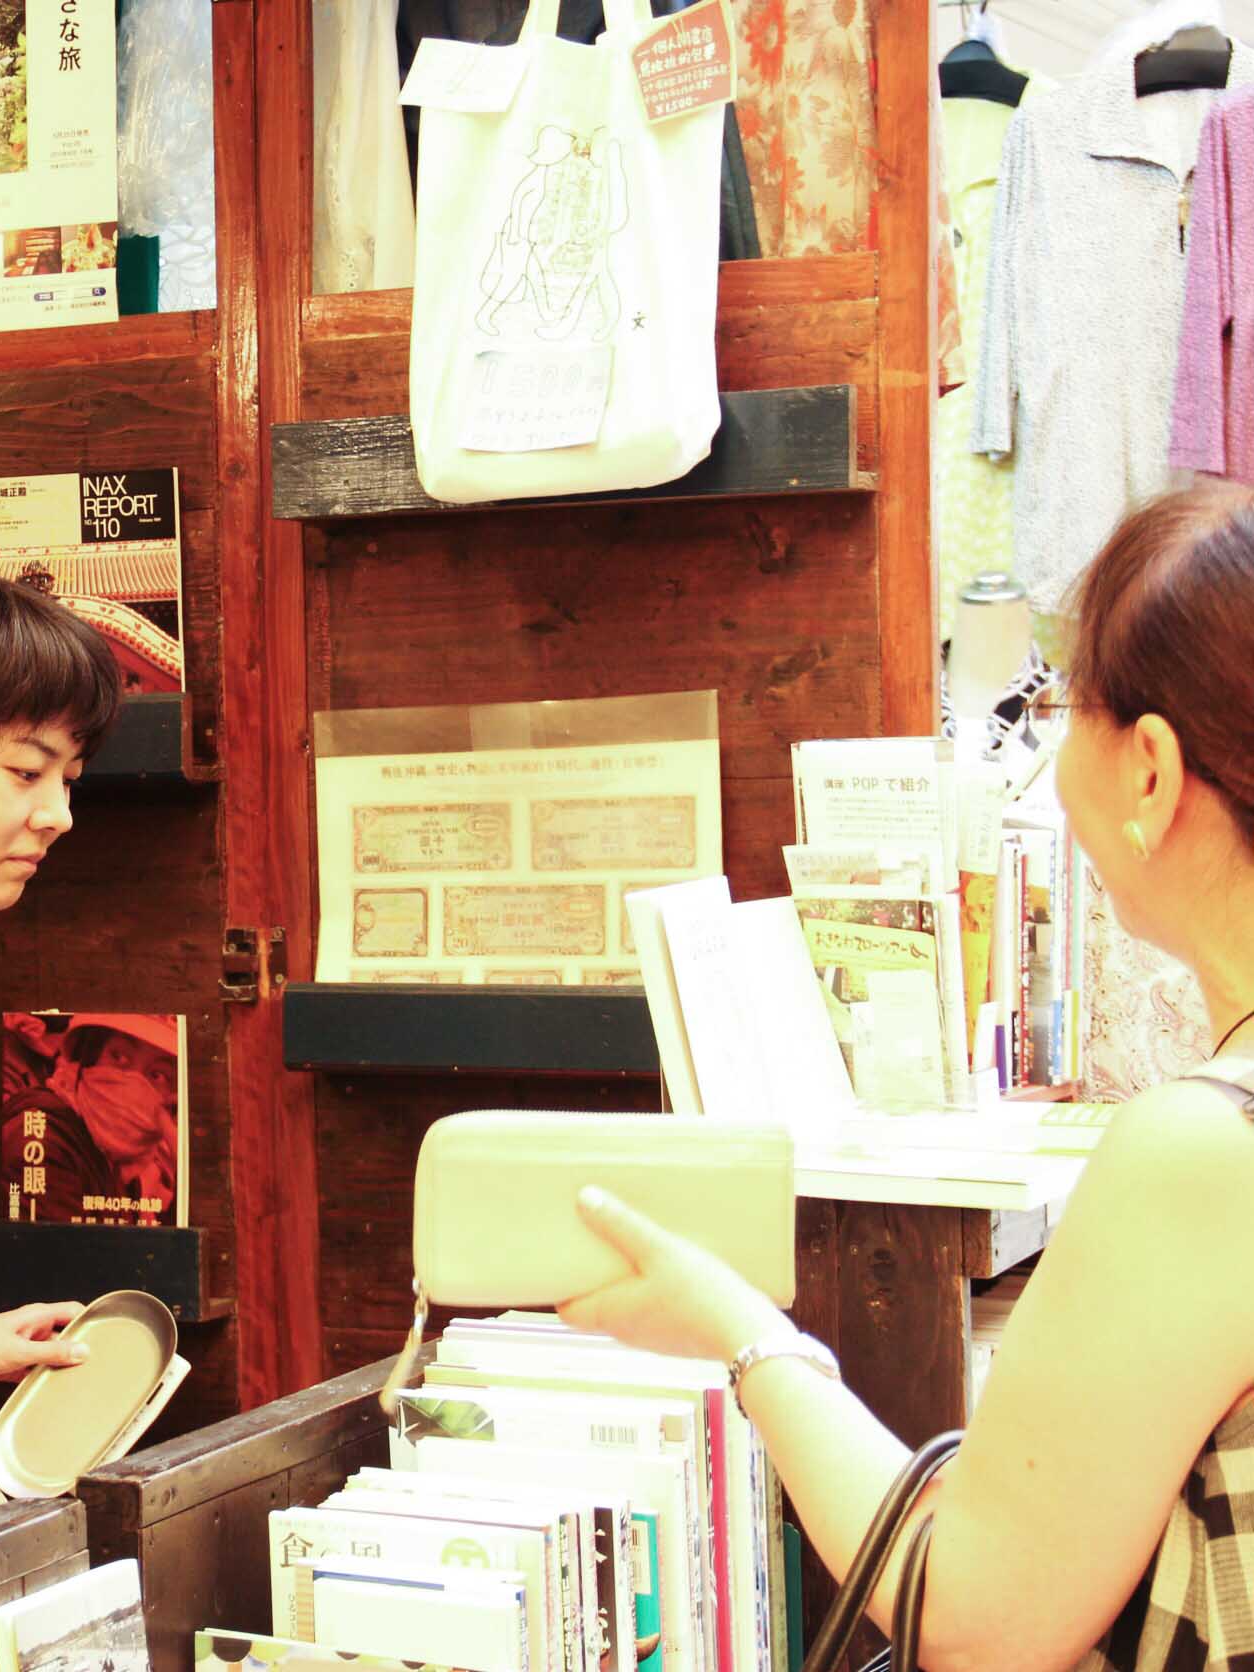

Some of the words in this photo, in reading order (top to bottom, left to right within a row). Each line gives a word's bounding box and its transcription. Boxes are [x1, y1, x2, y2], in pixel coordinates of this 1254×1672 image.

[83, 475, 127, 497] INAX
[84, 494, 158, 518] REPORT
[92, 518, 121, 539] 110
